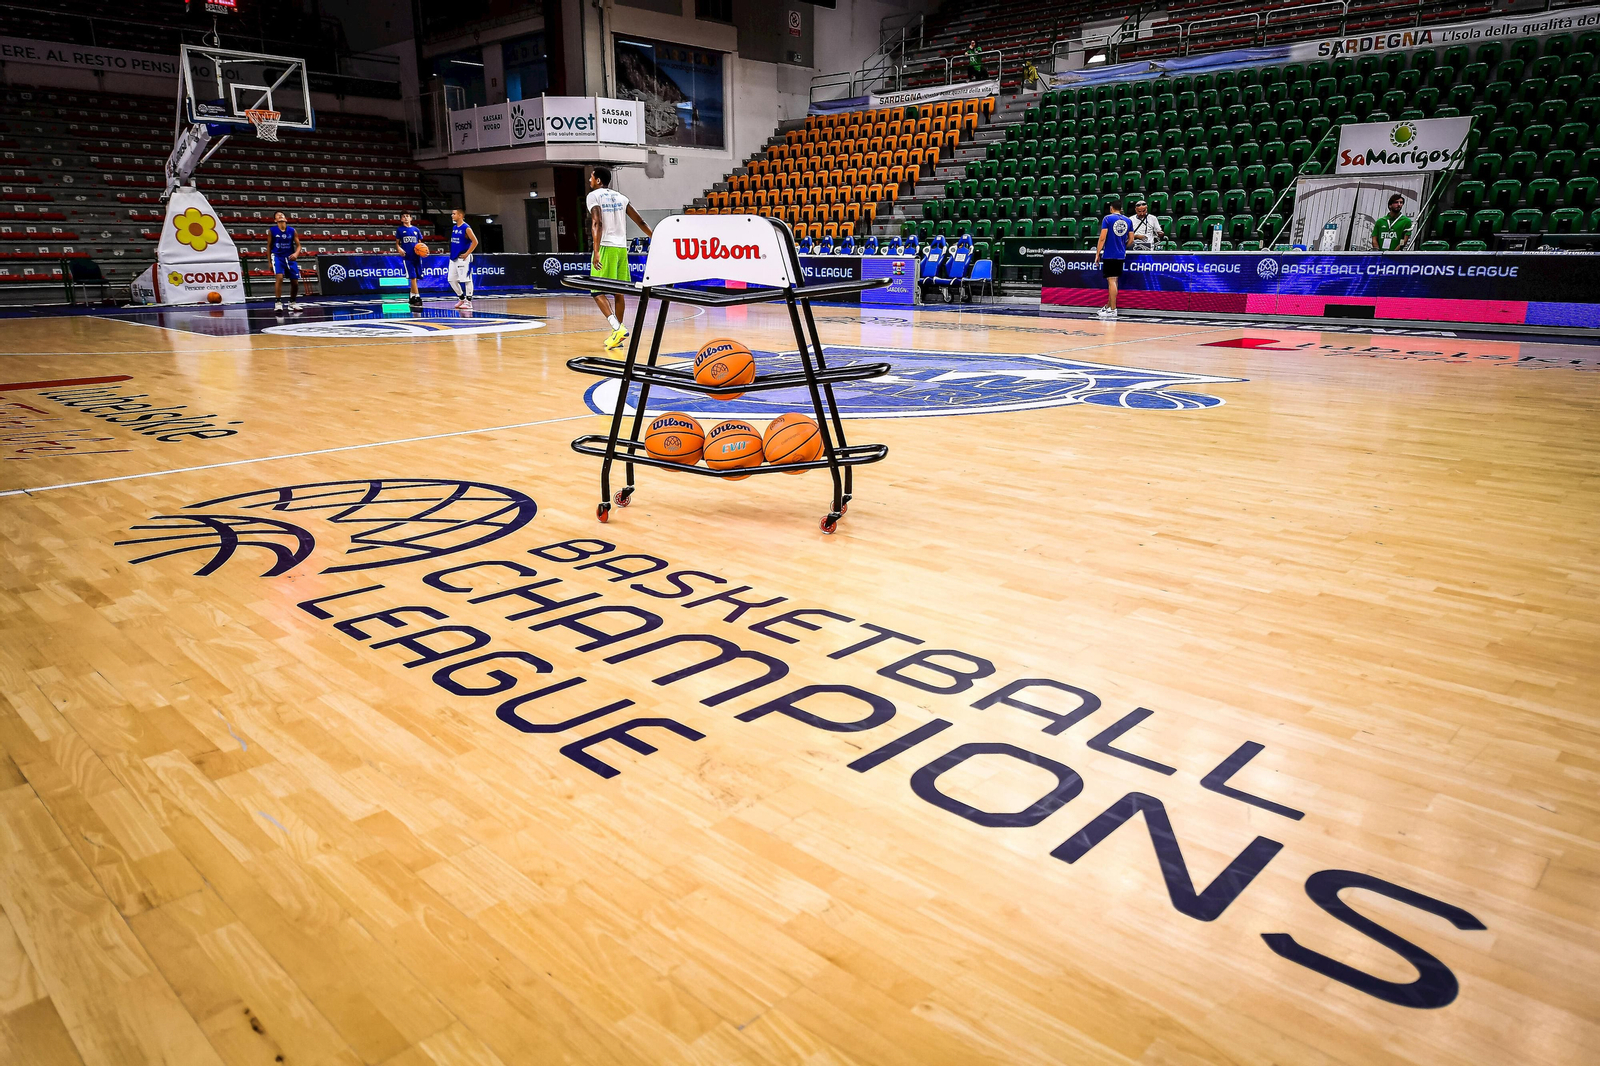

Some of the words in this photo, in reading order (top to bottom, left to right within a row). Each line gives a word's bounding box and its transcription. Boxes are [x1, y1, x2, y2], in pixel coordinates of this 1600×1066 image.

[1317, 30, 1434, 57] SARDEGNA
[1484, 25, 1520, 38] della
[1522, 17, 1572, 36] qualità
[46, 49, 70, 62] AL
[73, 53, 127, 69] RESTO
[879, 93, 923, 105] SARDEGNA
[483, 114, 503, 122] SASSARI
[602, 108, 632, 117] SASSARI
[455, 120, 472, 132] Foschi
[484, 123, 501, 131] NUORO
[602, 117, 629, 126] NUORO
[672, 237, 761, 261] Wilson
[472, 266, 505, 276] LEAGUE
[815, 267, 853, 278] LEAGUE
[1130, 262, 1194, 273] CHAMPIONS
[1196, 262, 1241, 274] LEAGUE
[1281, 264, 1364, 276] BASKETBALL
[1366, 265, 1455, 276] CHAMPIONS
[1457, 265, 1519, 277] LEAGUE
[184, 271, 239, 284] CONAD
[695, 344, 734, 367] Wilson
[37, 386, 244, 444] lubelskie
[652, 417, 694, 431] Wilson
[710, 423, 752, 438] Wilson
[297, 585, 706, 779] LEAGUE
[527, 538, 1305, 821] BASKETBALL
[423, 560, 1488, 1009] CHAMPIONS
